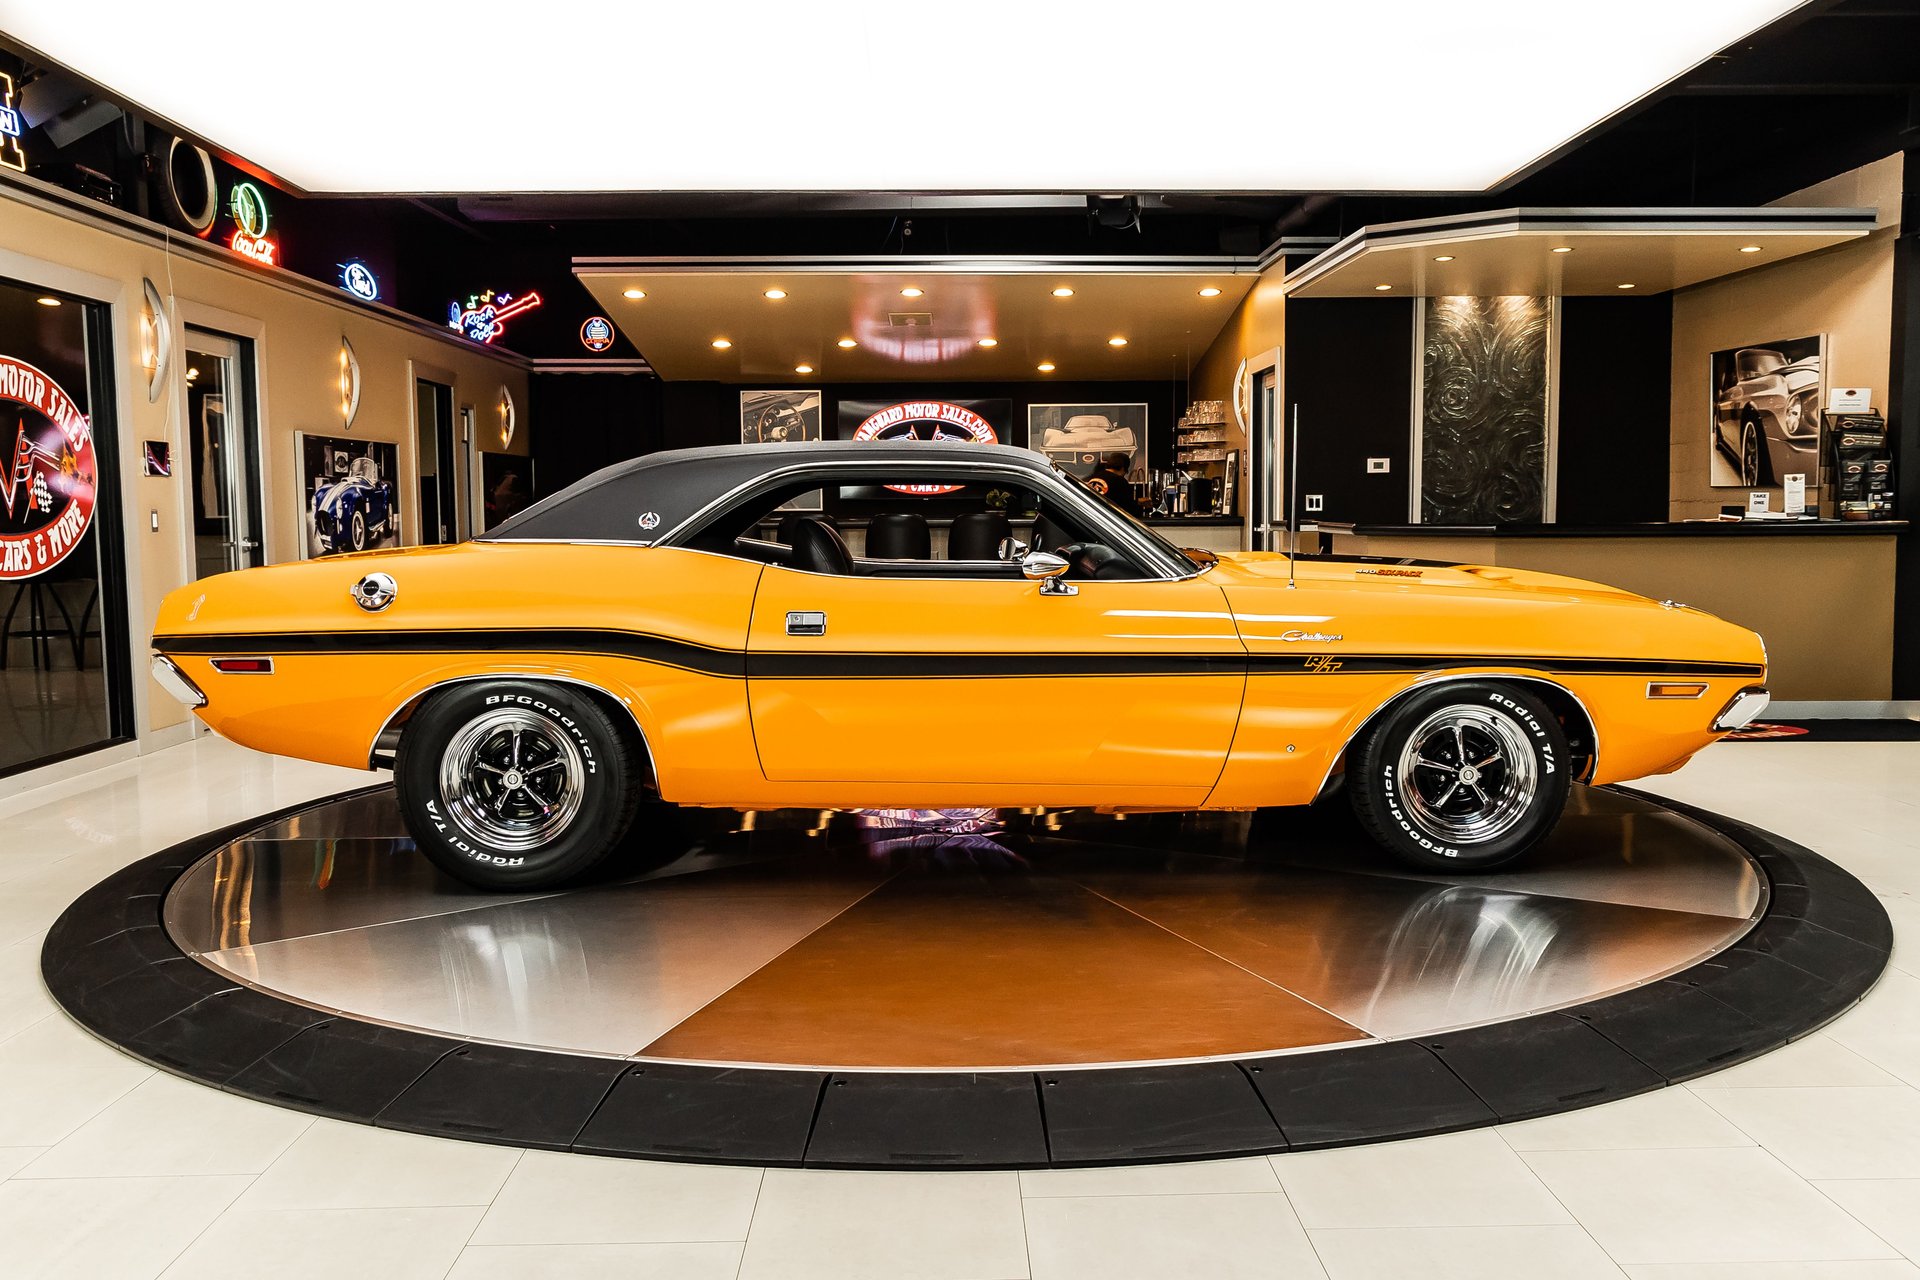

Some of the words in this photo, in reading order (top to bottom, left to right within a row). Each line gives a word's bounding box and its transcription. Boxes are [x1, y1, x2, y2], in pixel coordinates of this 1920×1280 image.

[465, 307, 494, 327] Rock
[47, 387, 88, 452] SALES
[856, 406, 904, 442] ANGUARD
[904, 403, 939, 418] MOTOR
[34, 533, 47, 564] &
[49, 499, 86, 558] MORE
[1304, 655, 1343, 673] R/T
[486, 694, 596, 774] BFGoodrich
[1489, 693, 1545, 738] Radial
[1542, 743, 1555, 774] T/A
[425, 799, 447, 833] T/A
[1384, 765, 1458, 858] BFGoodrich
[448, 836, 525, 866] Radial
